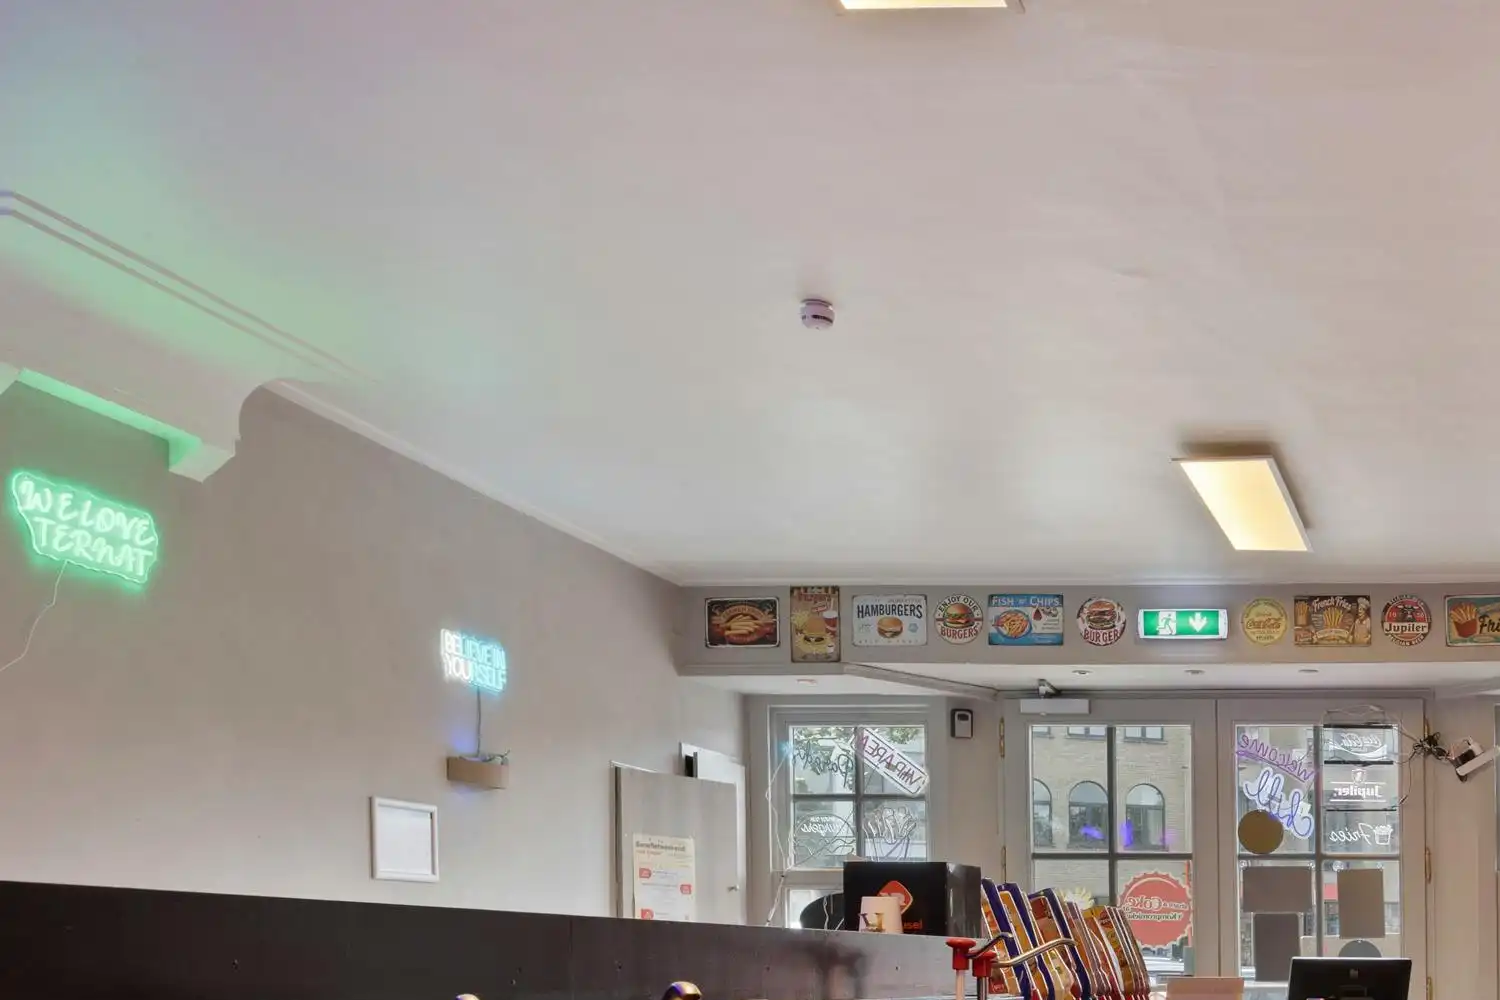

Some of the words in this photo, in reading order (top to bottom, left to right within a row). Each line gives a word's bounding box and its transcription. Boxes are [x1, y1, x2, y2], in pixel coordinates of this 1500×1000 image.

[18, 480, 78, 521] WE
[81, 500, 156, 546] LOVE
[32, 516, 154, 576] TERNAT
[938, 595, 960, 612] ENJOY
[962, 597, 979, 612] OUR
[991, 596, 1014, 606] FISH
[1029, 595, 1060, 607] CHIPS
[1312, 597, 1335, 612] French
[856, 603, 923, 619] HAMBURGERS
[940, 625, 979, 640] BURGERS
[1083, 628, 1121, 643] BURGER
[1384, 624, 1427, 633] Jupiler
[443, 630, 494, 667] BELIEVE
[443, 652, 507, 690] YOURSELF
